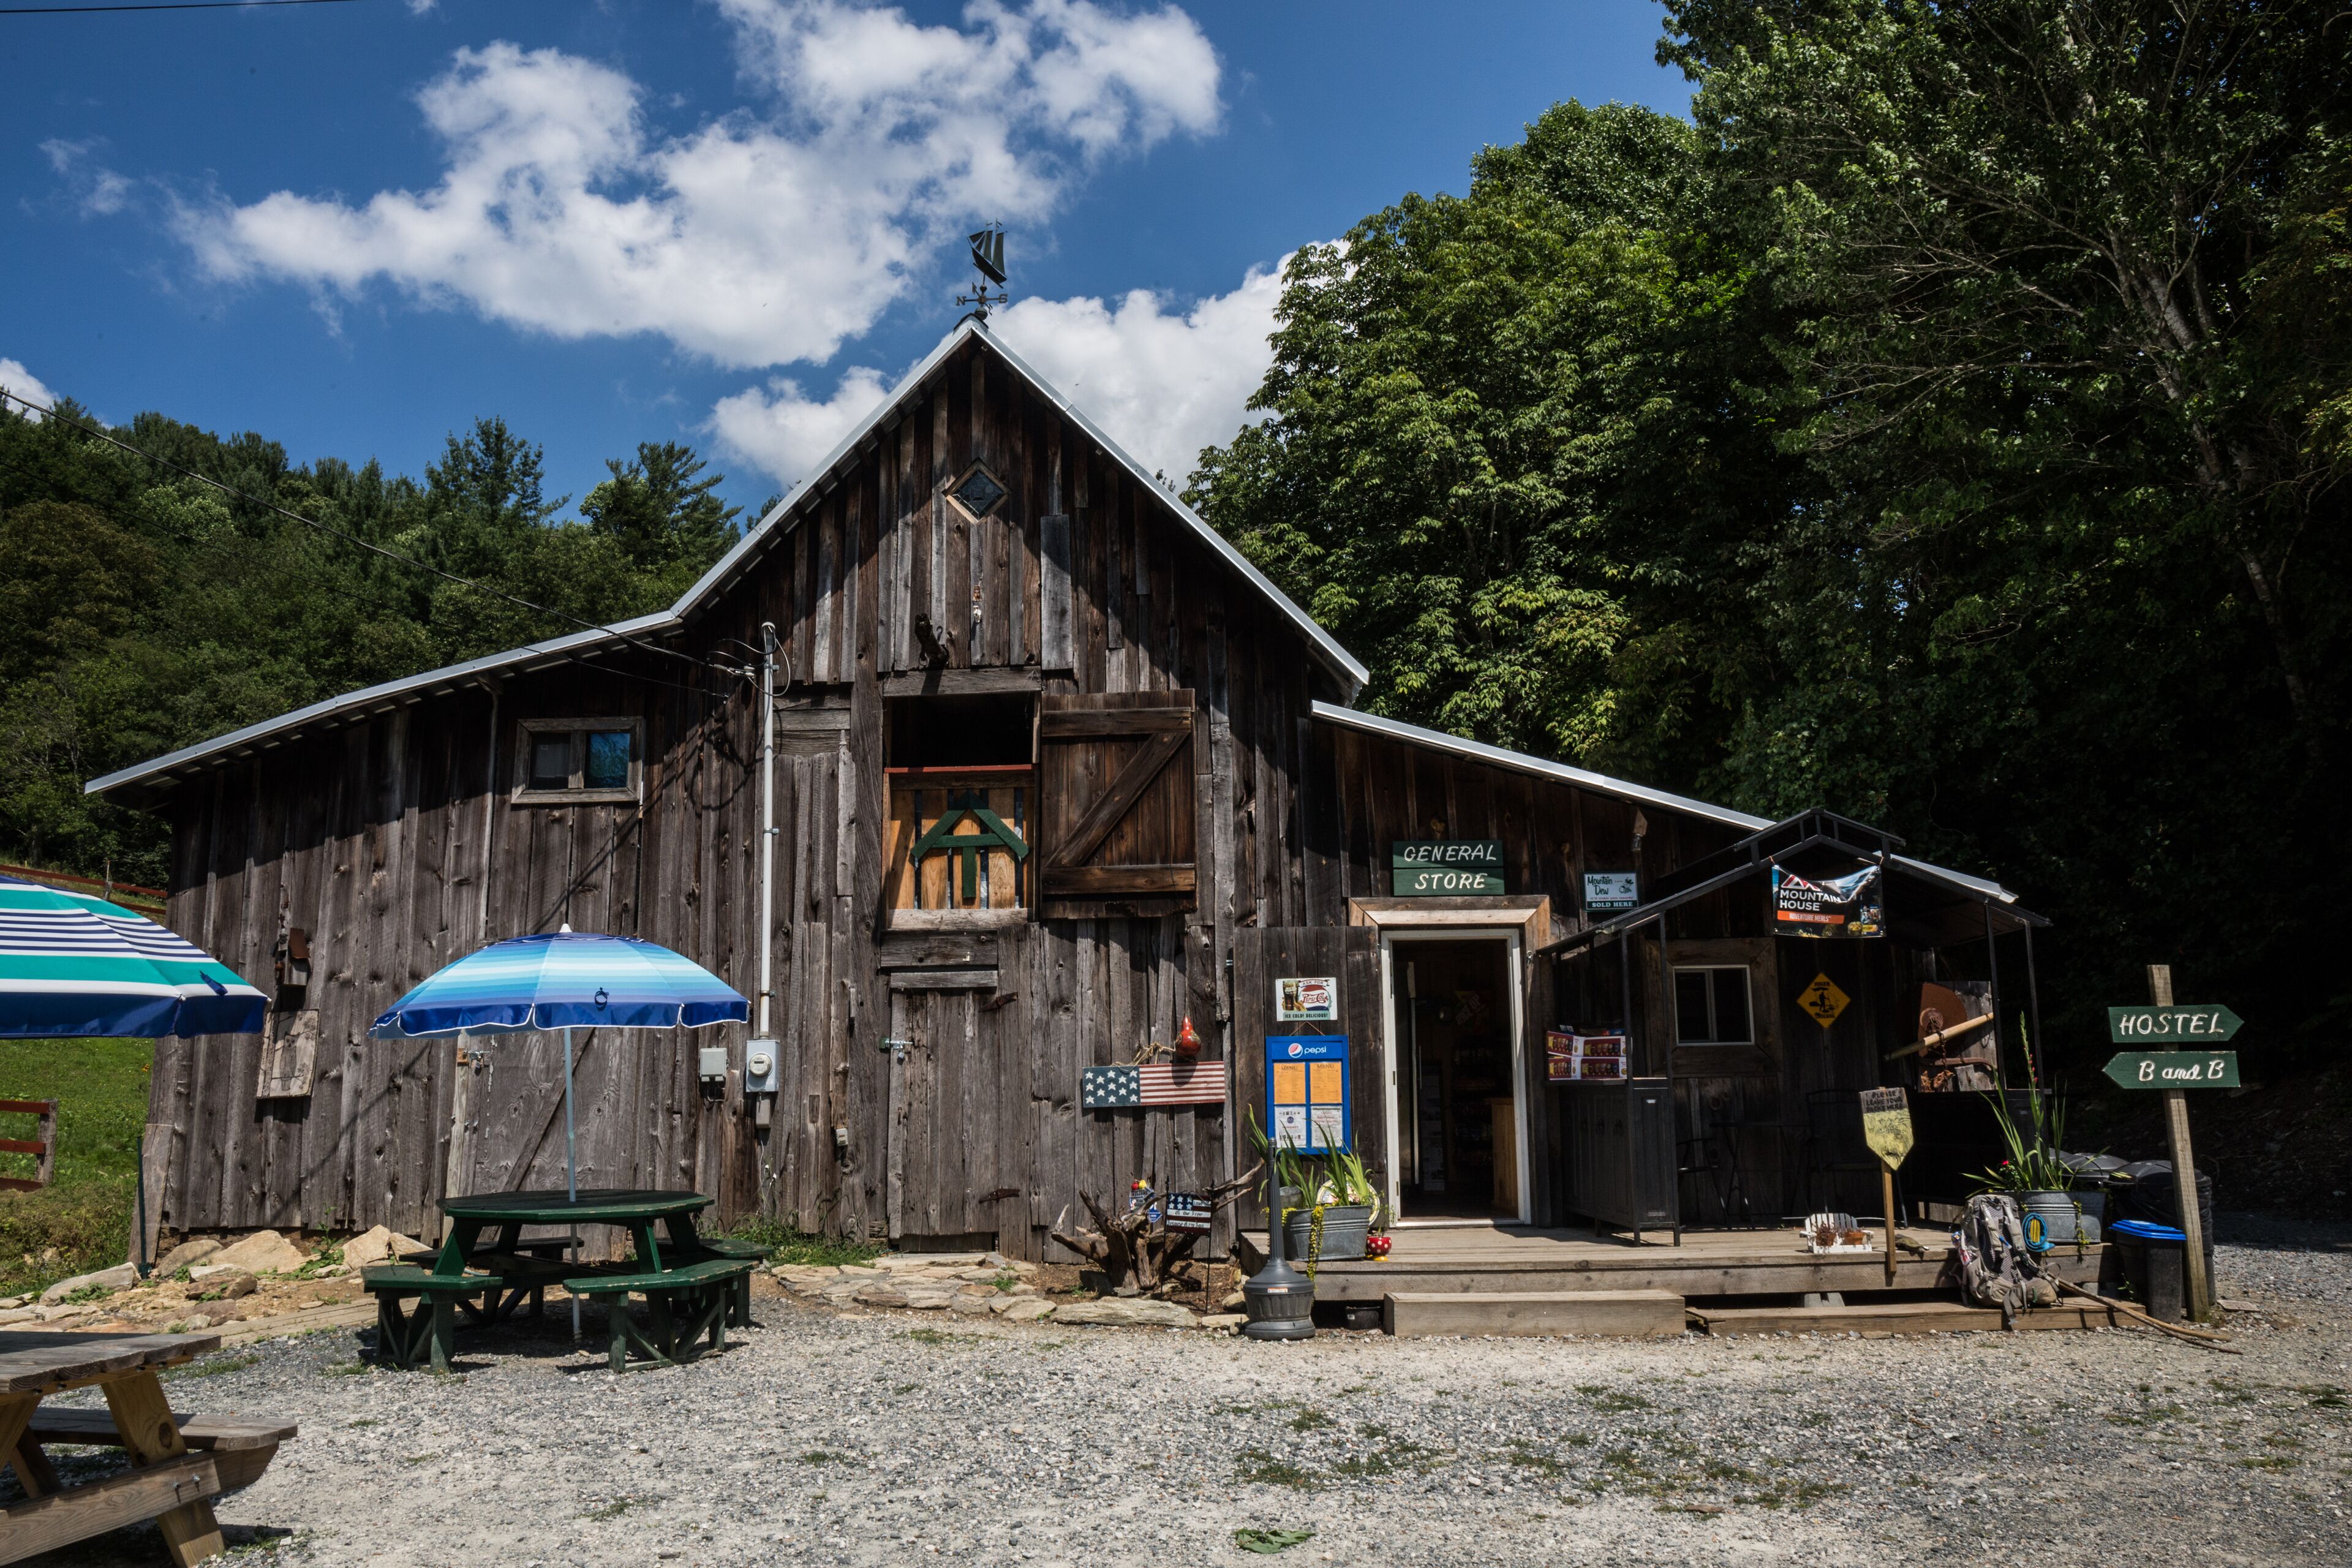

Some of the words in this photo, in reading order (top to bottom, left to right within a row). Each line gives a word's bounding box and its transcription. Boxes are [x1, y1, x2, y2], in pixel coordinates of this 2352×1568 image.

[956, 296, 967, 306] N
[999, 293, 1008, 304] S
[1404, 843, 1496, 862] GENERAL
[1414, 872, 1488, 889] STORE
[1588, 875, 1612, 885] Mountain
[1593, 884, 1609, 895] Dew
[1780, 889, 1842, 903] MOUNTAIN
[1780, 899, 1820, 911] HOUSE
[2119, 1012, 2224, 1035] HOSTEL
[1304, 1046, 1327, 1055] pepsi
[2139, 1060, 2156, 1082] B
[2162, 1063, 2204, 1080] and
[2207, 1059, 2225, 1080] B
[1872, 1090, 1896, 1099] PLEASE
